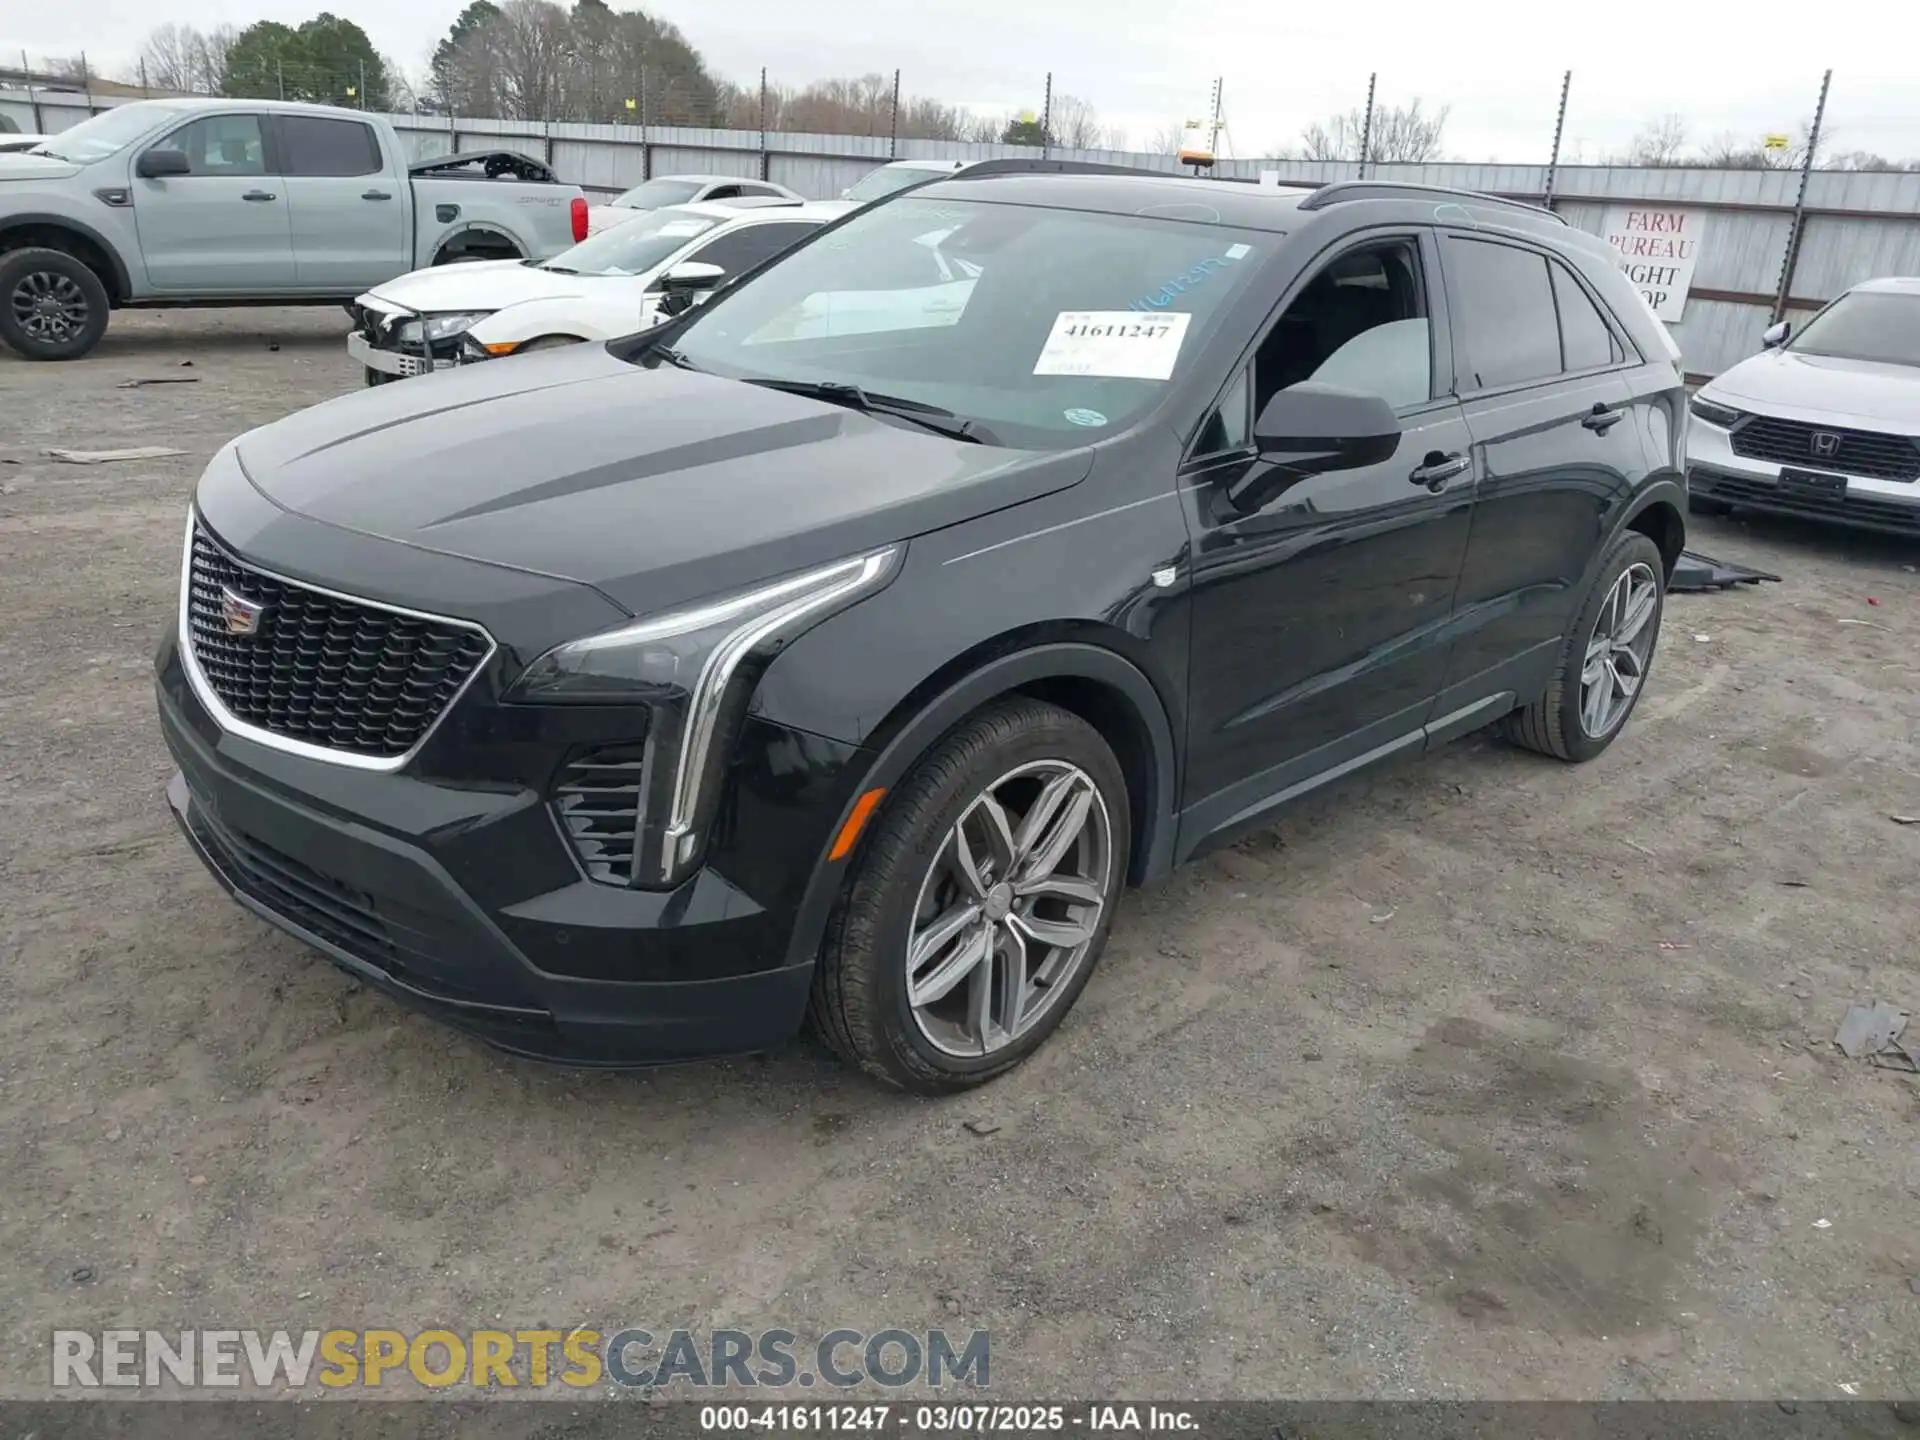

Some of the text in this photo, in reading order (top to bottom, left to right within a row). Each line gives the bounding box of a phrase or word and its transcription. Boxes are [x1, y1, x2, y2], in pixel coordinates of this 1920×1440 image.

[1625, 210, 1686, 233] FARM
[1619, 263, 1681, 286] IGHT
[1064, 323, 1171, 338] 41611247
